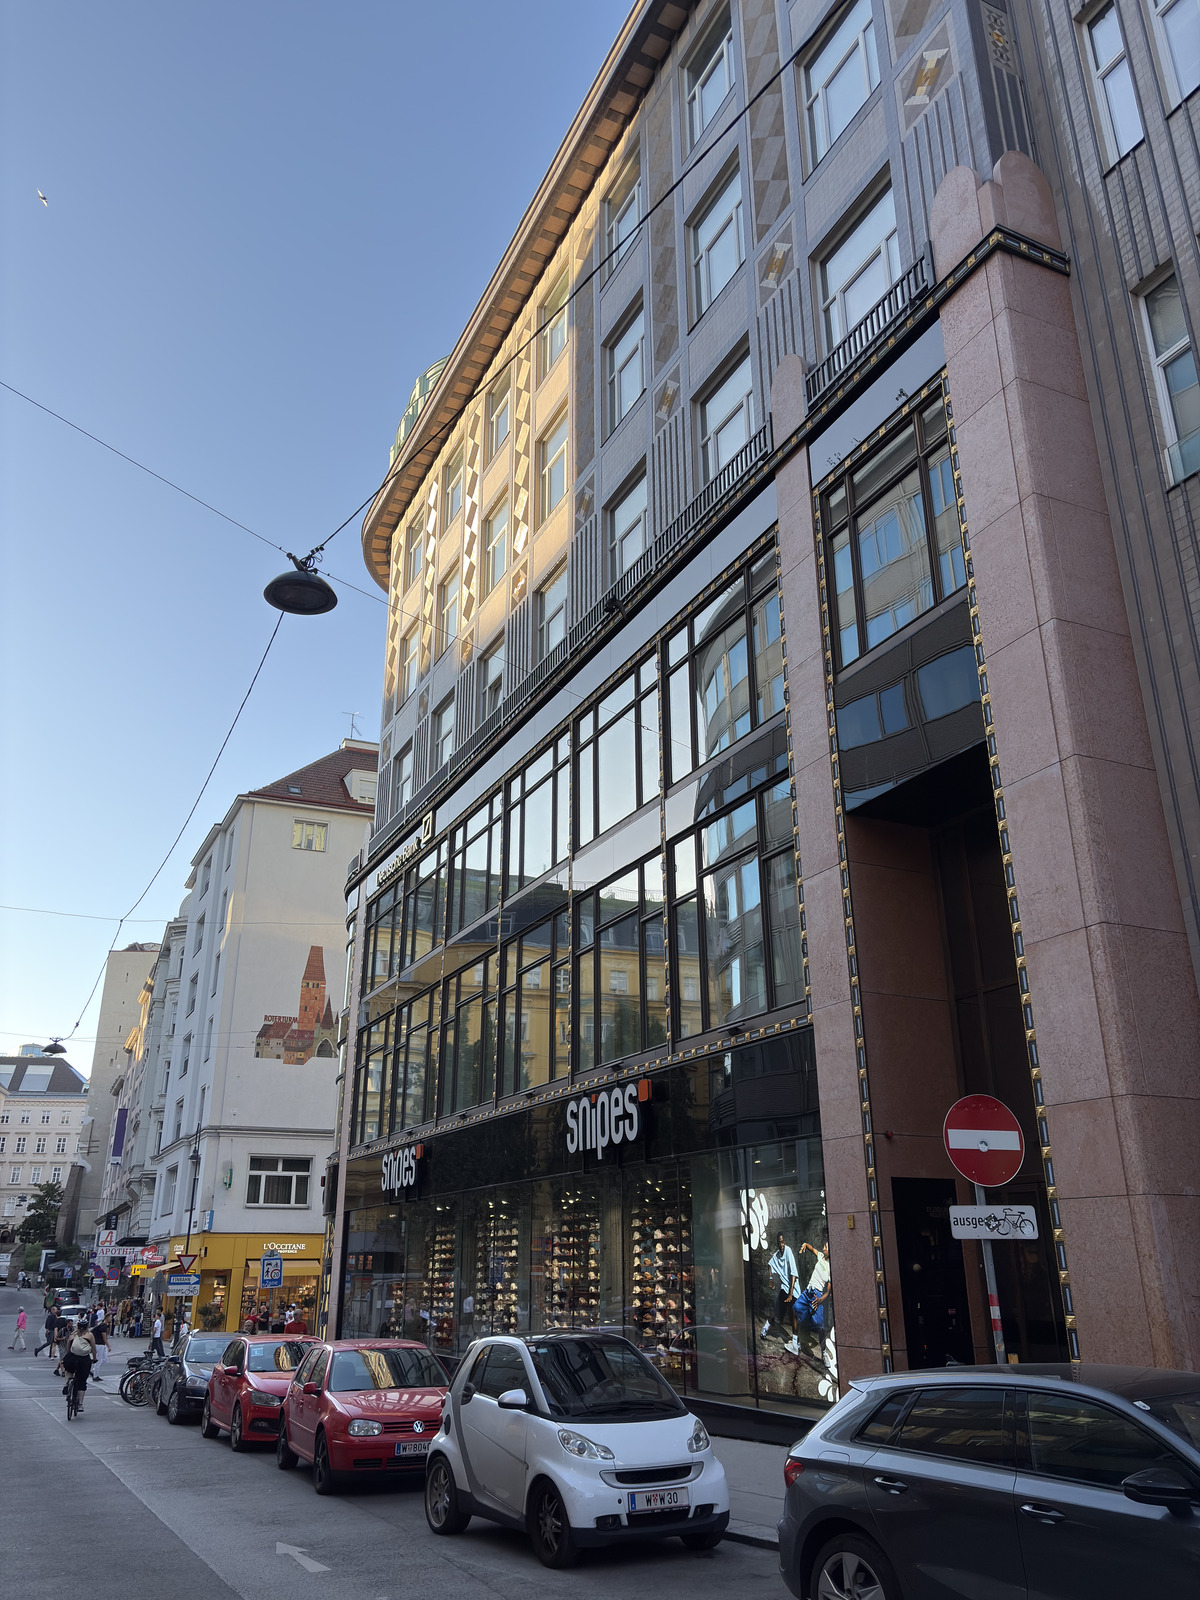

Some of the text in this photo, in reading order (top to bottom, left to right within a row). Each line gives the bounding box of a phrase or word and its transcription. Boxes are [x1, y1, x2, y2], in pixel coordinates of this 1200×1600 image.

[566, 1083, 639, 1160] snipes
[381, 1146, 417, 1196] snipes
[952, 1215, 986, 1229] ausge
[401, 1443, 407, 1453] W
[645, 1494, 653, 1507] W
